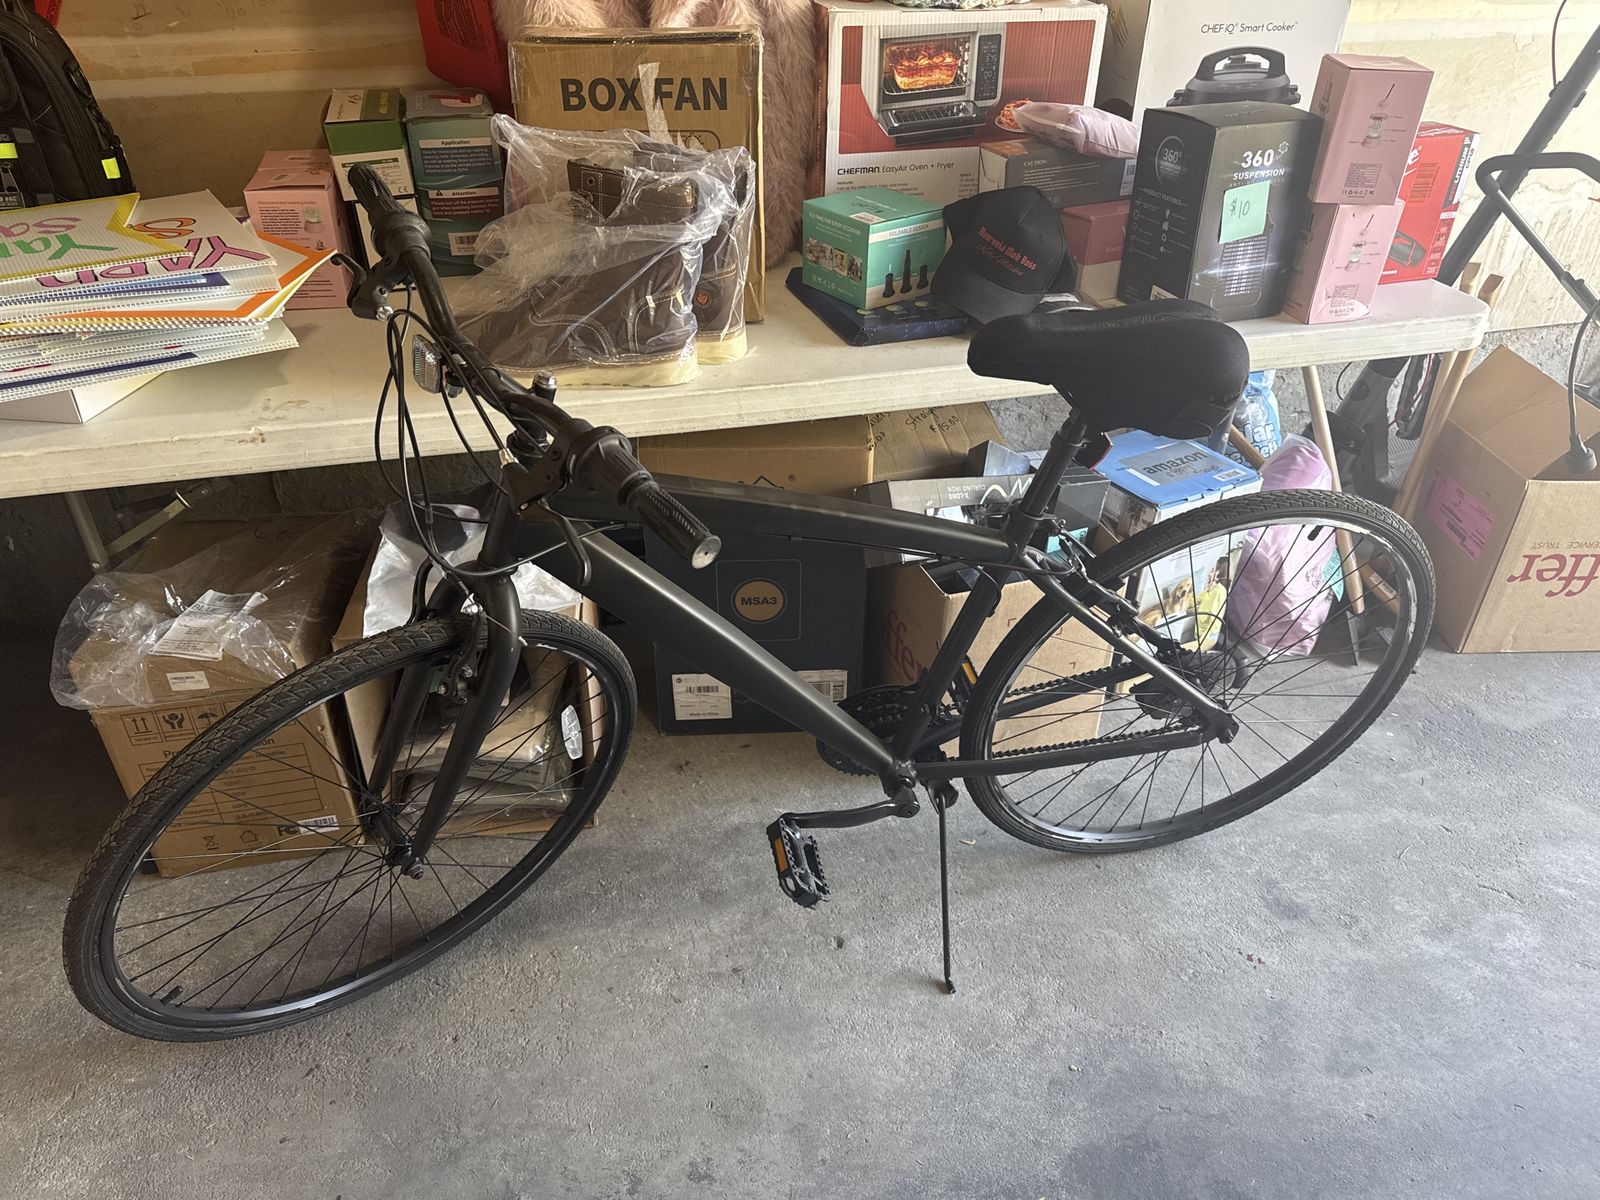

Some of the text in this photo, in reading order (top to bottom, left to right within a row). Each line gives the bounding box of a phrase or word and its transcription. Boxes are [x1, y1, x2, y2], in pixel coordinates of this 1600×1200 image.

[1239, 23, 1265, 33] Smart
[560, 77, 728, 113] BOX FAN
[440, 138, 471, 147] Application
[1241, 149, 1275, 169] 360
[837, 166, 880, 176] CHEFMAN
[881, 165, 908, 175] EasyAir
[908, 164, 929, 172] Oven
[936, 161, 956, 171] Fryer
[1233, 168, 1285, 181] SUSPENSION
[1229, 196, 1251, 219] $10
[1142, 451, 1209, 475] amazon
[1530, 541, 1600, 550] ERVICE TRUST
[740, 595, 778, 607] MSA3
